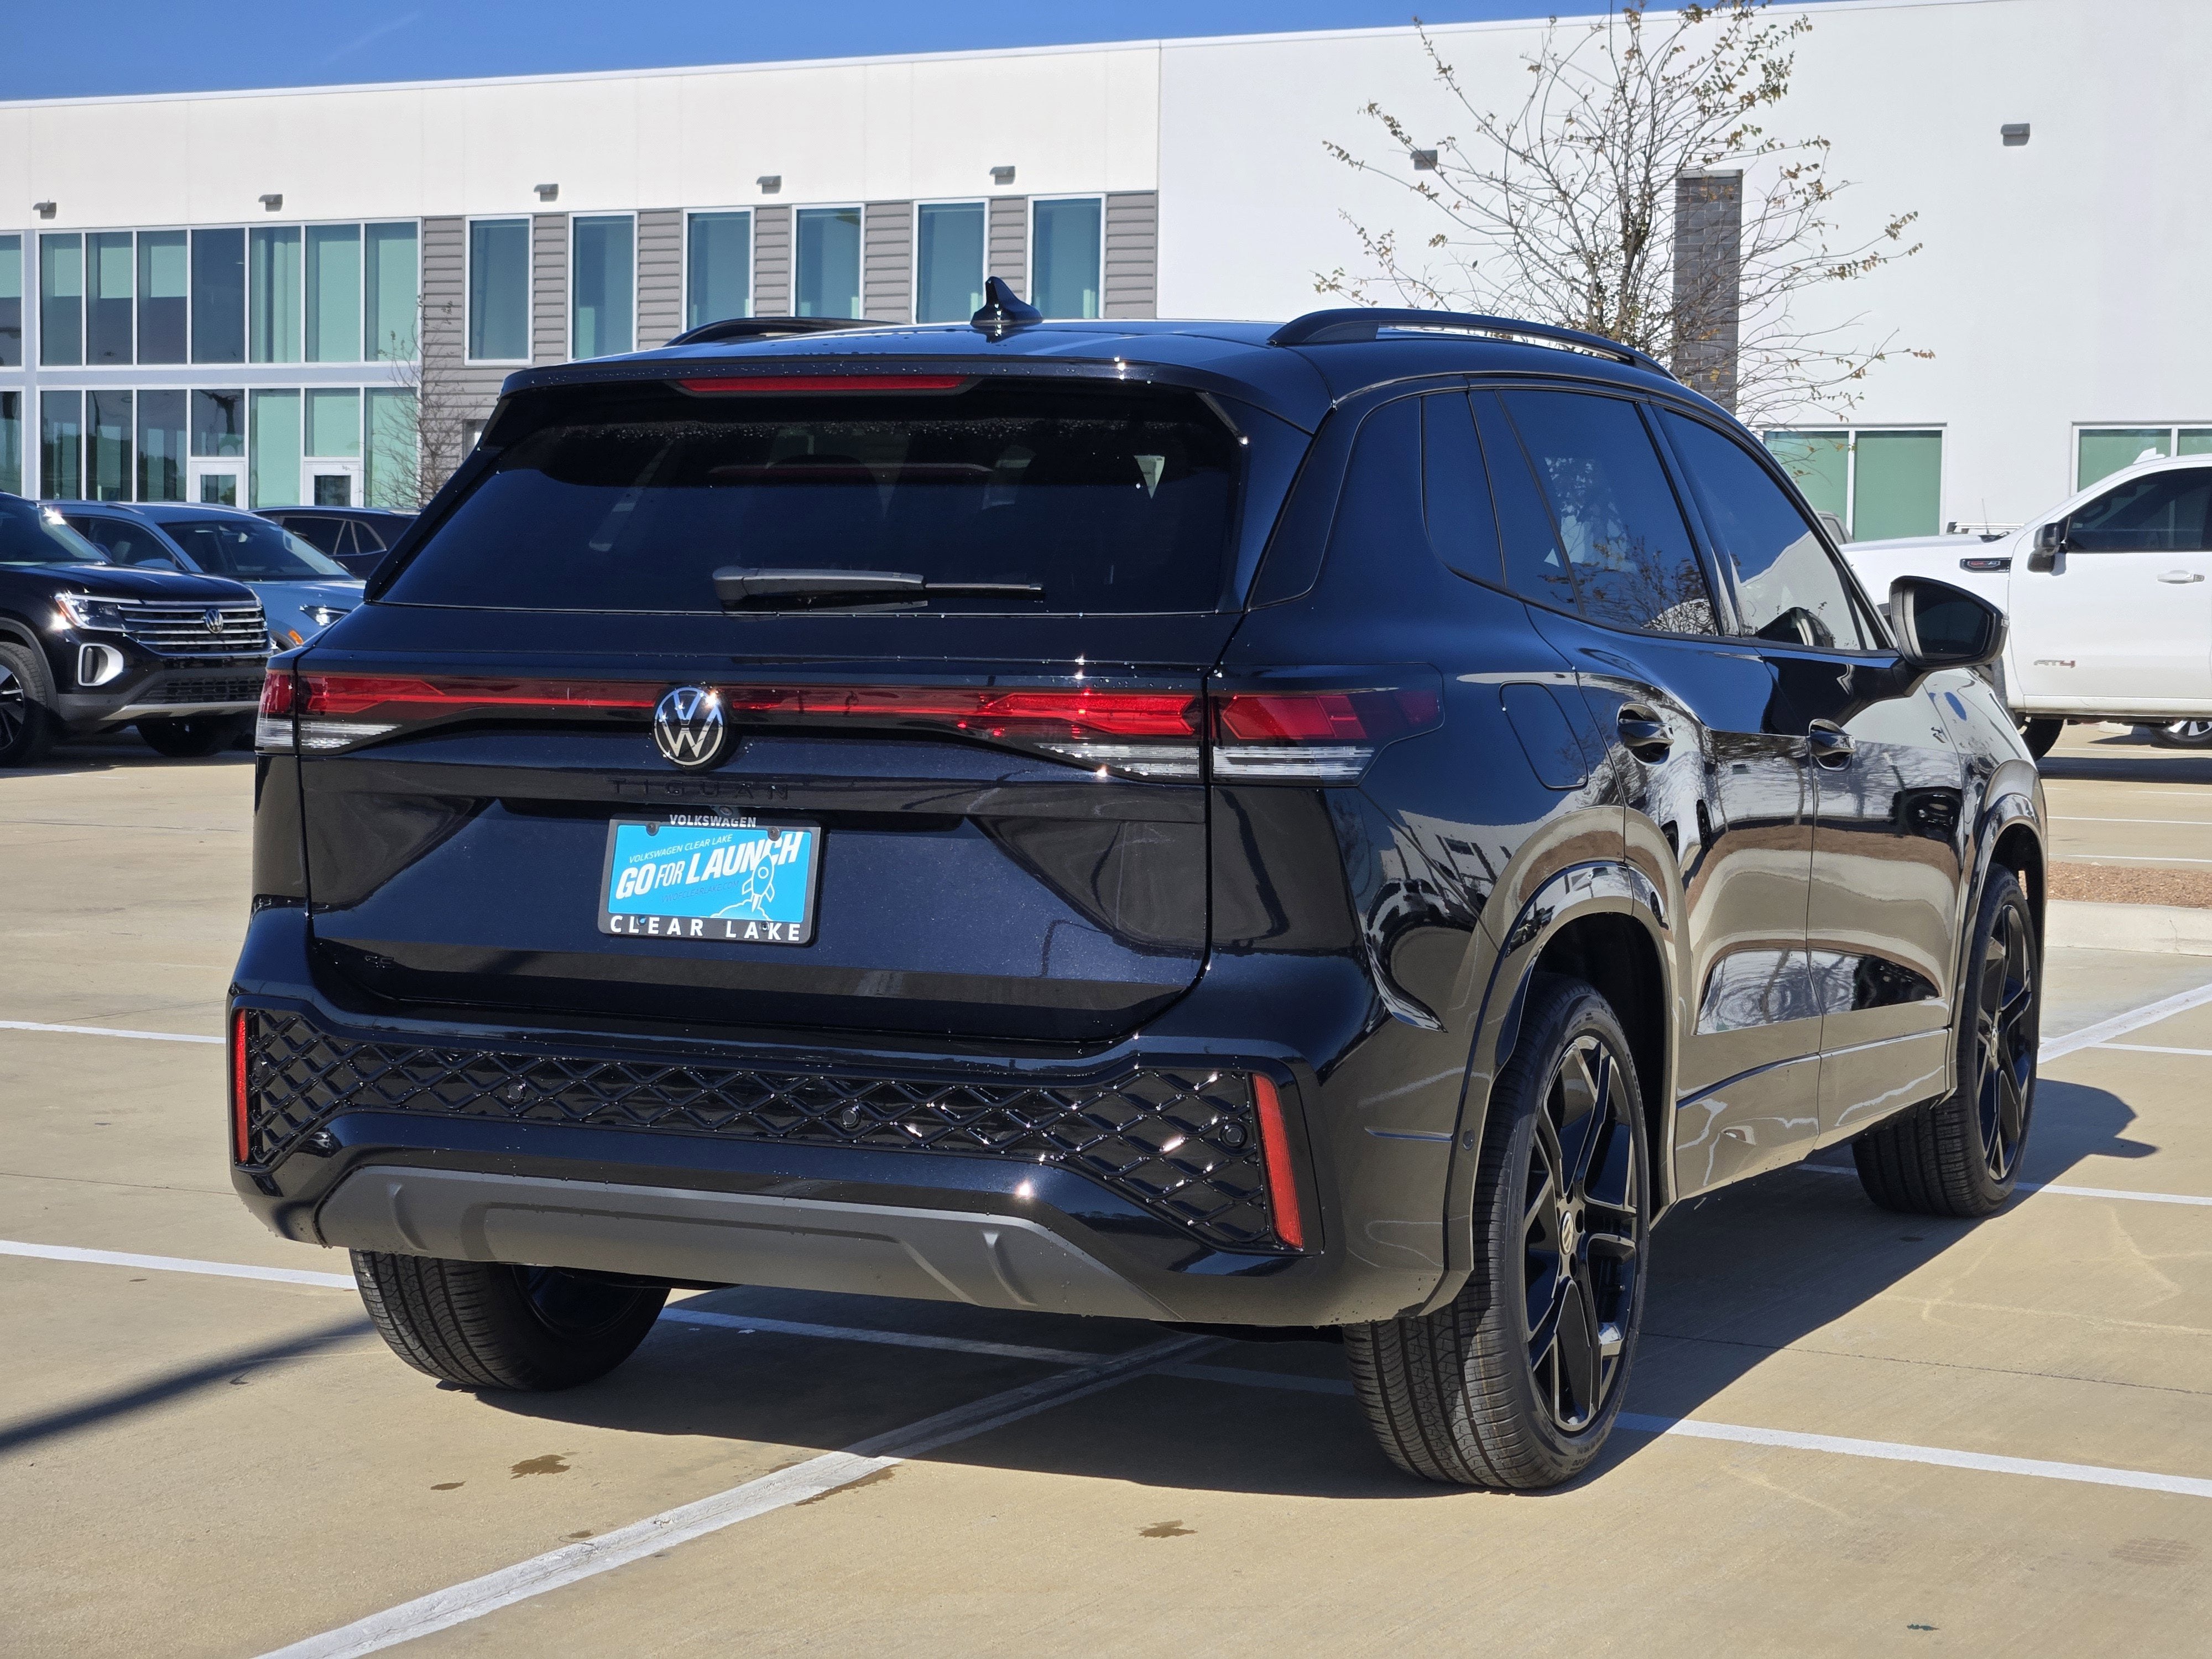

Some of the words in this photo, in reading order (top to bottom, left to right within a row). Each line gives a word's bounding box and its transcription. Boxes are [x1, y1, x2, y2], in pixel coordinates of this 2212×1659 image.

[609, 778, 789, 801] TIGUAN
[669, 814, 757, 828] VOLKSWAGEN
[629, 844, 683, 864] VOLKSWAGEN
[685, 838, 710, 851] CLEAR
[711, 834, 733, 845] LAKE
[615, 863, 656, 900] GO
[655, 860, 686, 889] FOR
[685, 831, 805, 885] LAUNCH
[611, 915, 703, 936] CLEAR
[726, 921, 801, 941] LAKE
